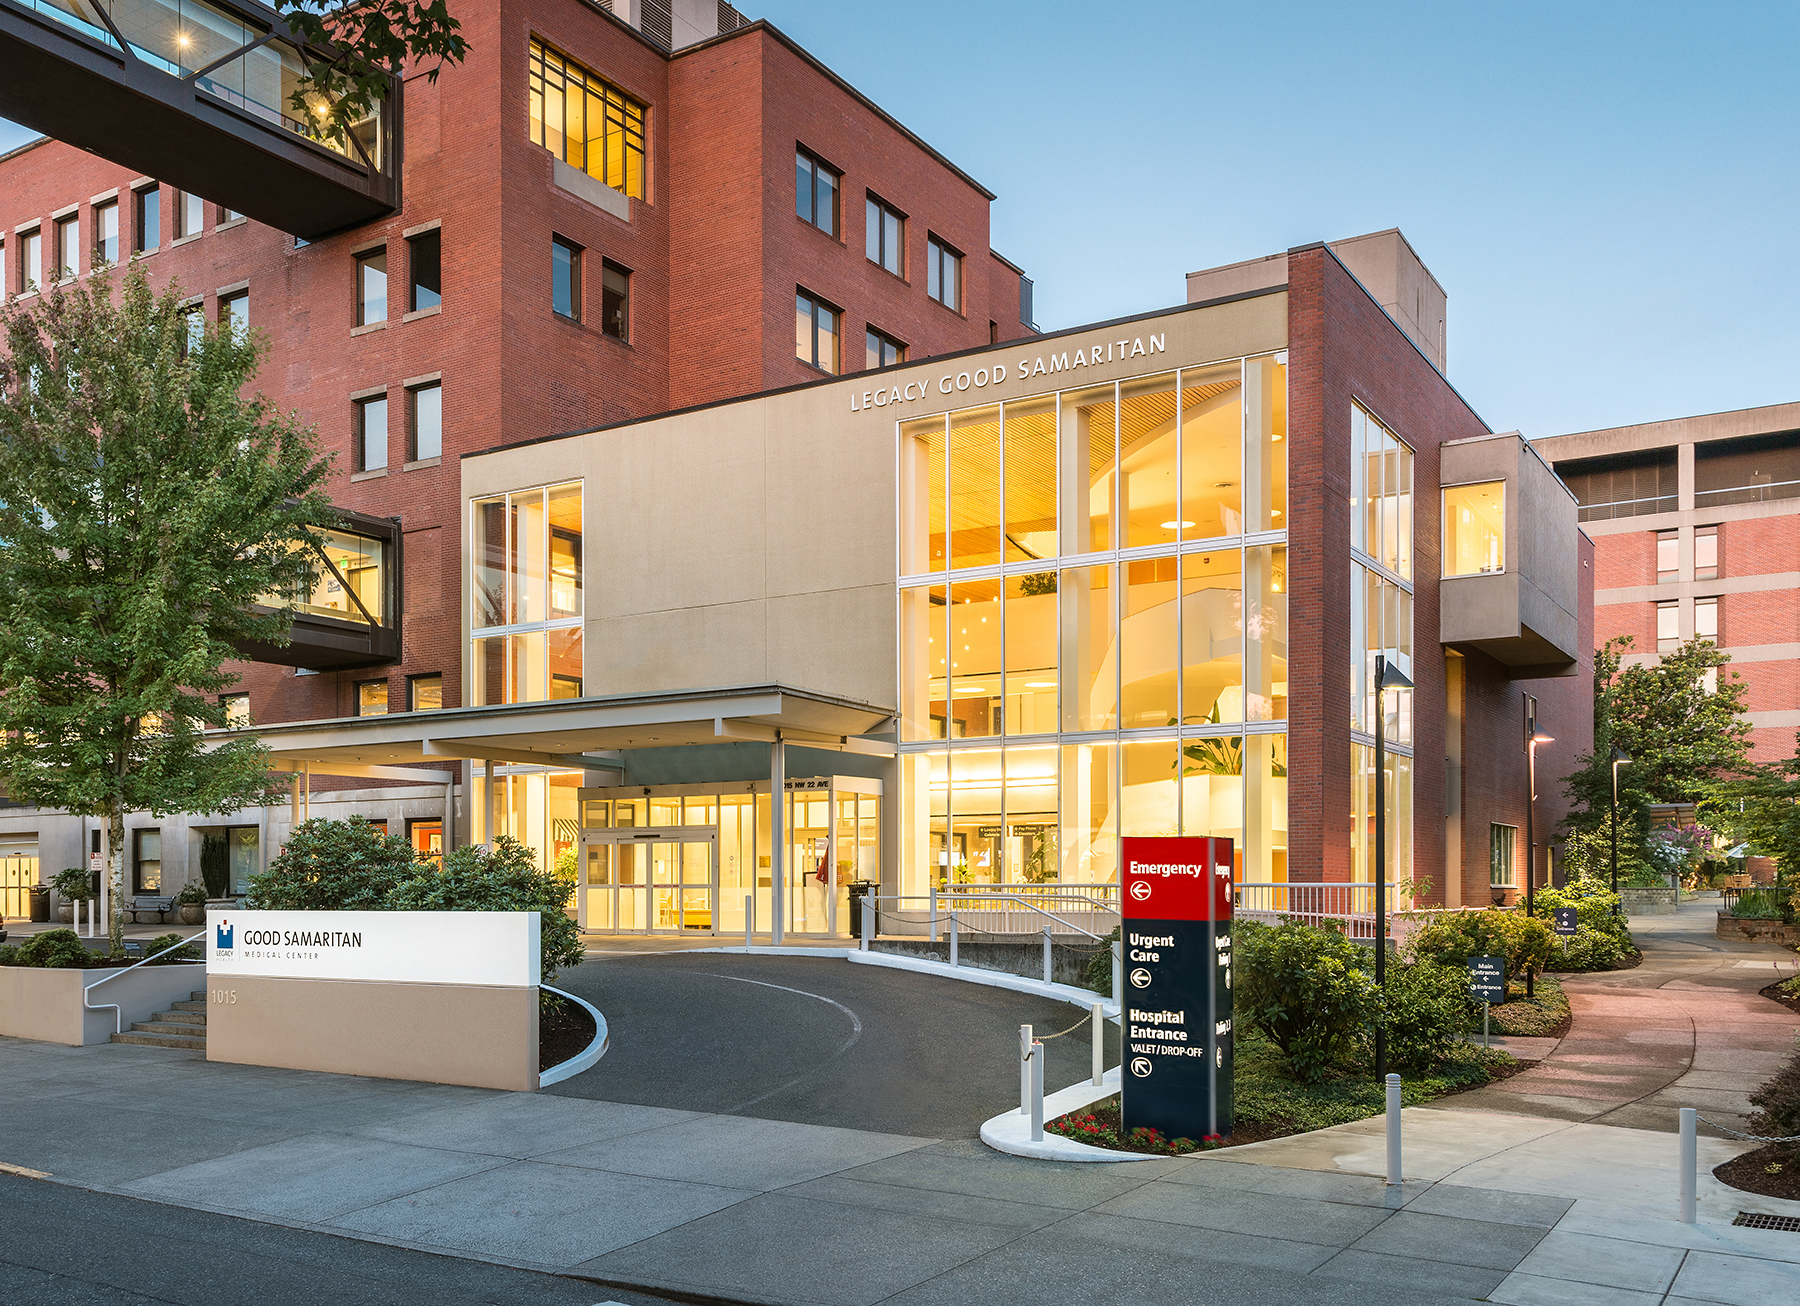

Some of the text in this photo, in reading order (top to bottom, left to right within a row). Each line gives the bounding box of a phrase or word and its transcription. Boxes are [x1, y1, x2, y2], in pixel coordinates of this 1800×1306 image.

[851, 333, 1166, 411] LEGACY GOOD SAMARITAN
[1130, 861, 1203, 878] Emergency
[244, 930, 362, 948] GOOD SAMARITAN
[1129, 933, 1175, 949] Urgent
[244, 951, 319, 960] MEDICAL CENTER
[1129, 949, 1160, 963] Care
[211, 989, 238, 1005] 1015
[1129, 1008, 1185, 1026] Hospital
[1130, 1025, 1188, 1041] Entrance
